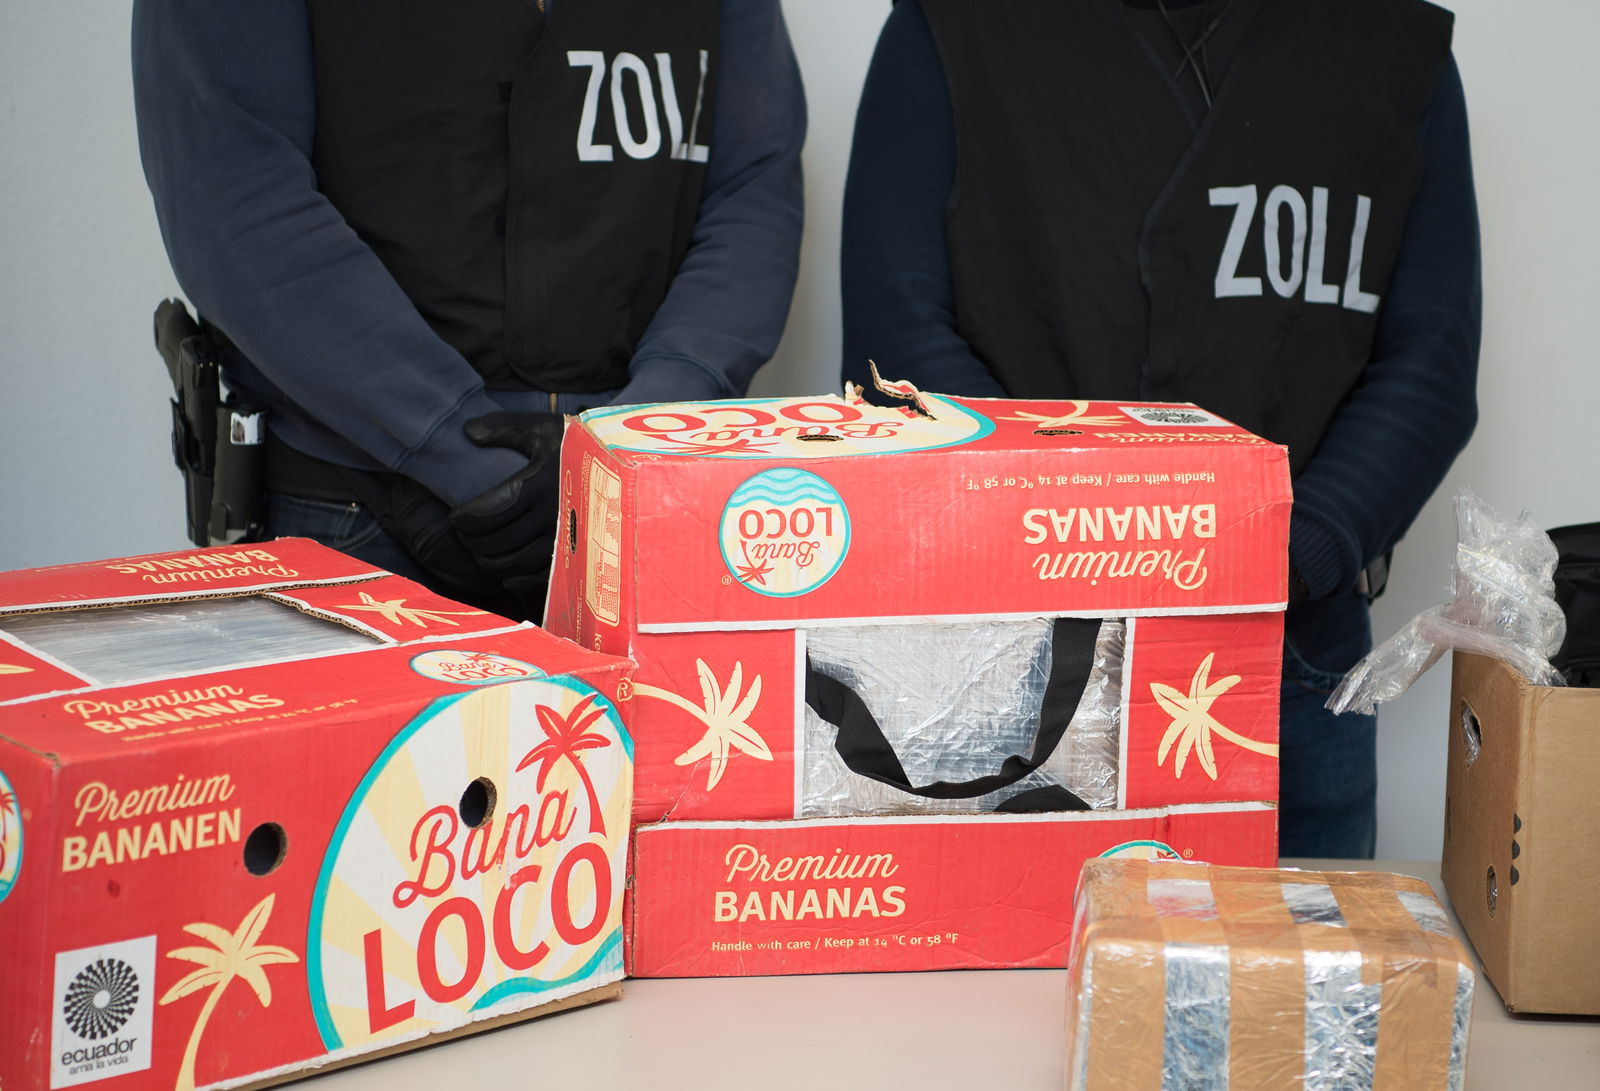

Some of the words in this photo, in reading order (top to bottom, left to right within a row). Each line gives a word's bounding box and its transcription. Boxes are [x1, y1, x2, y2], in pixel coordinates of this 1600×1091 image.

[566, 49, 709, 163] ZOLL
[1208, 183, 1380, 314] ZOLL
[622, 402, 917, 433] OCO
[983, 477, 999, 489] 58
[1003, 477, 1016, 487] or
[1037, 475, 1052, 486] 14
[1055, 475, 1068, 485] at
[1072, 474, 1102, 487] Keep
[1115, 475, 1140, 484] care
[1144, 473, 1170, 486] with
[1174, 472, 1216, 483] Handle
[738, 507, 832, 540] LOCO
[1022, 503, 1217, 544] BANANAS
[105, 549, 279, 574] BANANAS
[751, 540, 820, 567] Bana
[142, 564, 298, 584] Premium
[1032, 547, 1208, 591] Premium
[438, 661, 497, 672] Bana
[441, 667, 528, 680] LOCO
[63, 684, 244, 719] Premium
[85, 694, 286, 734] BANANAS
[74, 774, 236, 827] Premium
[62, 808, 242, 873] BANANEN
[393, 788, 577, 908] Bana
[725, 844, 899, 884] Premium
[714, 886, 907, 922] BANANAS
[363, 841, 612, 1035] LOCO
[712, 941, 752, 951] Handle
[757, 940, 782, 950] with
[786, 940, 811, 949] care
[824, 937, 854, 949] Keep
[858, 937, 870, 947] at
[874, 938, 888, 948] 14
[909, 935, 924, 945] or
[927, 935, 941, 945] 58
[61, 1037, 138, 1066] ecuador
[69, 1063, 93, 1075] ama
[95, 1060, 105, 1069] la
[107, 1055, 129, 1067] vida
